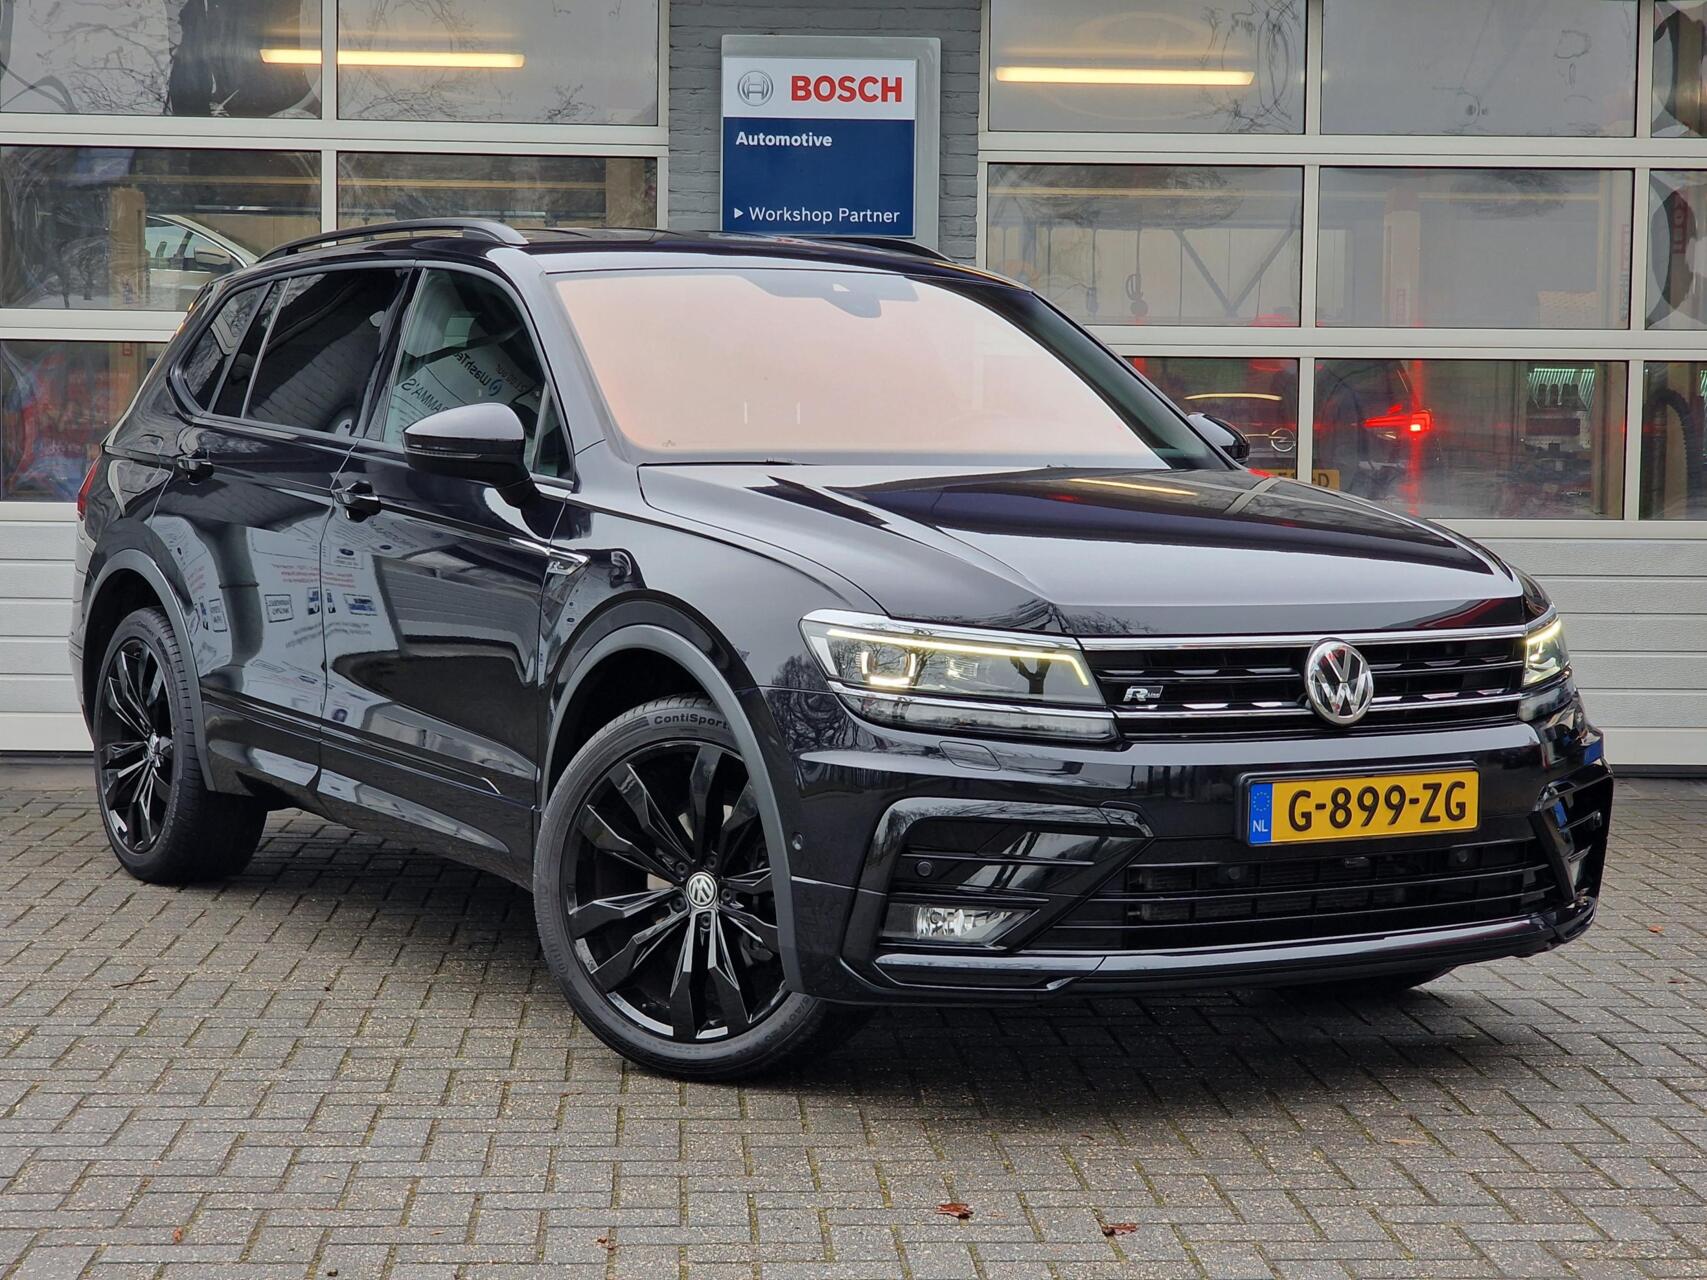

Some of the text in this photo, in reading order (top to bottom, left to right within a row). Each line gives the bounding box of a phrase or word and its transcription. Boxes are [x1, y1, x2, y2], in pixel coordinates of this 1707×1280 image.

[791, 75, 902, 103] BOSCH
[735, 131, 833, 147] Automotive
[749, 206, 901, 225] Workshop Partner
[653, 713, 731, 730] ContiSport
[1288, 781, 1466, 832] G-899-ZG
[1252, 819, 1269, 833] NL
